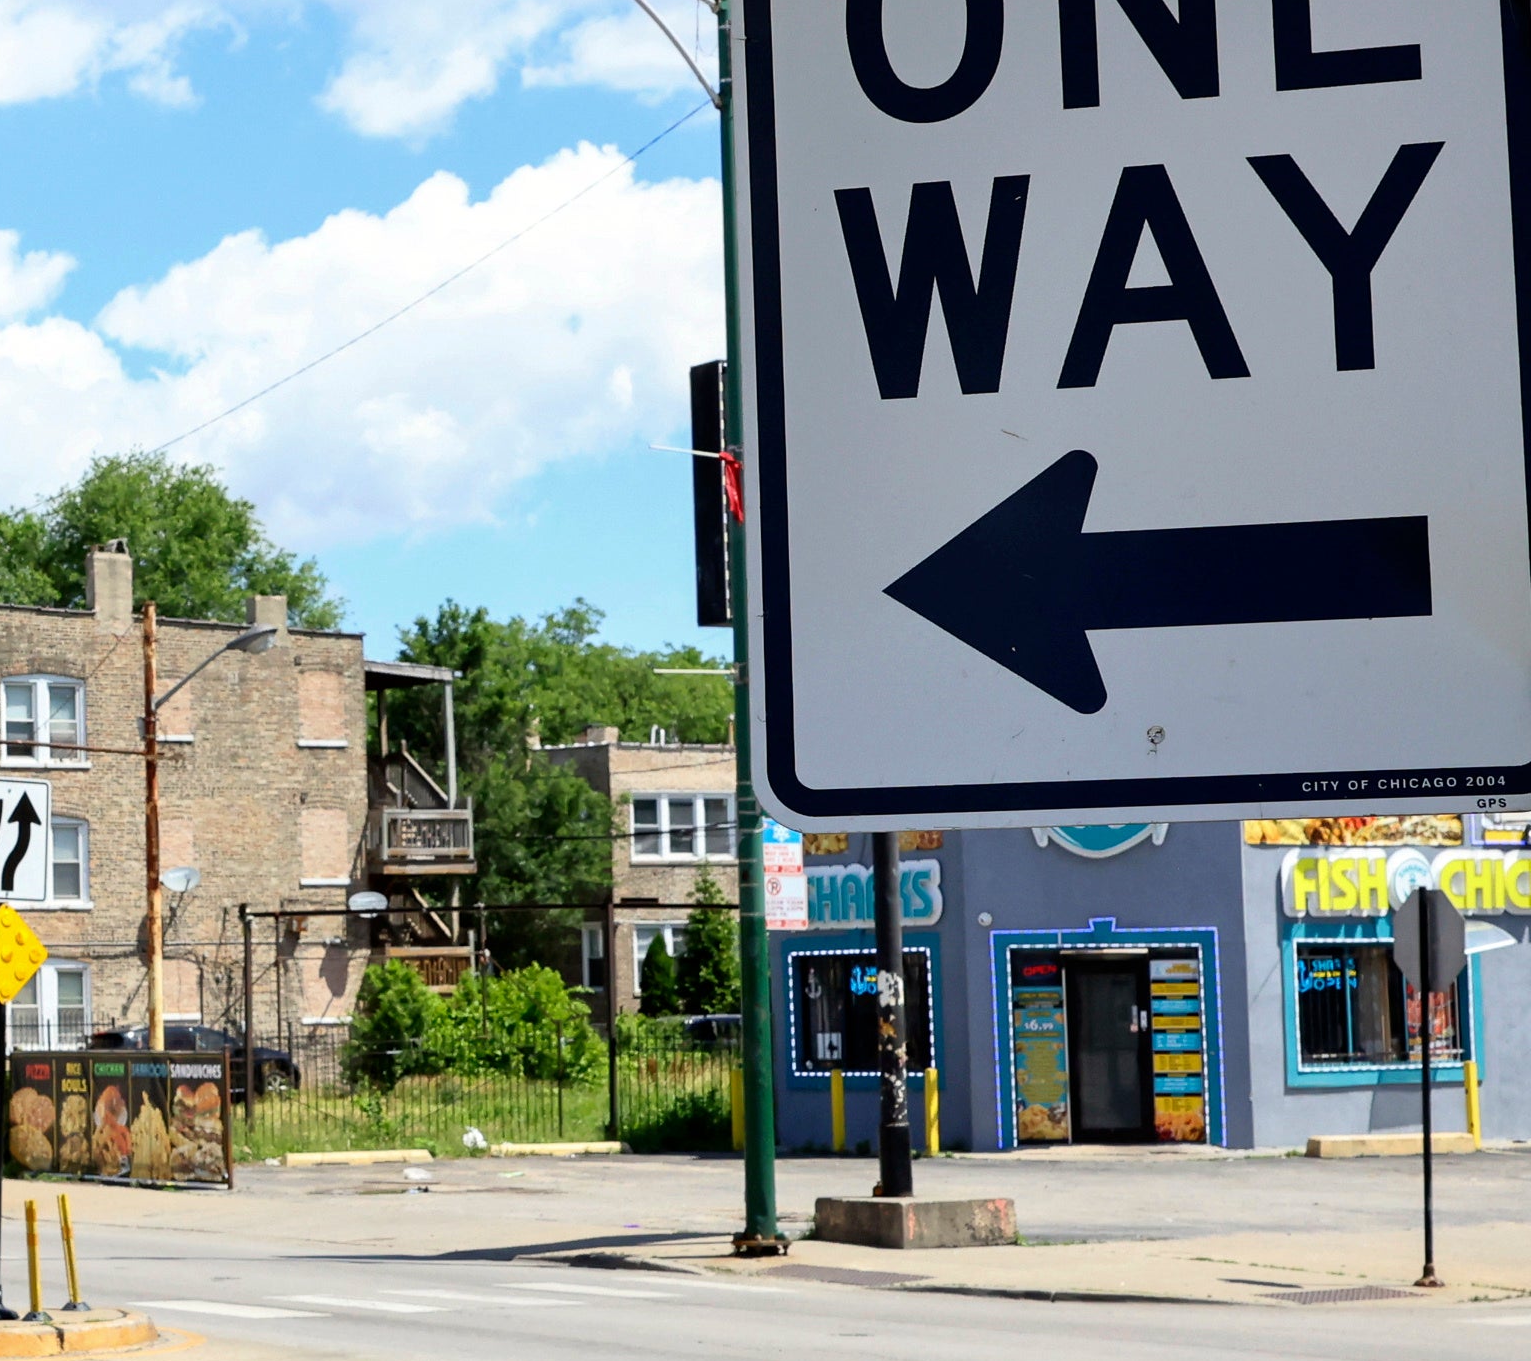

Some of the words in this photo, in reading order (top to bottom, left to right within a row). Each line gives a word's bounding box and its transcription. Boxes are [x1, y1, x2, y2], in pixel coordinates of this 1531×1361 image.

[834, 141, 1446, 401] WAY
[1301, 781, 1340, 793] CITY
[1347, 779, 1370, 791] OF
[1377, 776, 1458, 790] CHICAGO
[1465, 775, 1507, 788] 2004
[1476, 797, 1508, 809] GPS
[1292, 857, 1389, 911] FISH
[170, 1063, 222, 1079] SANDWICHES
